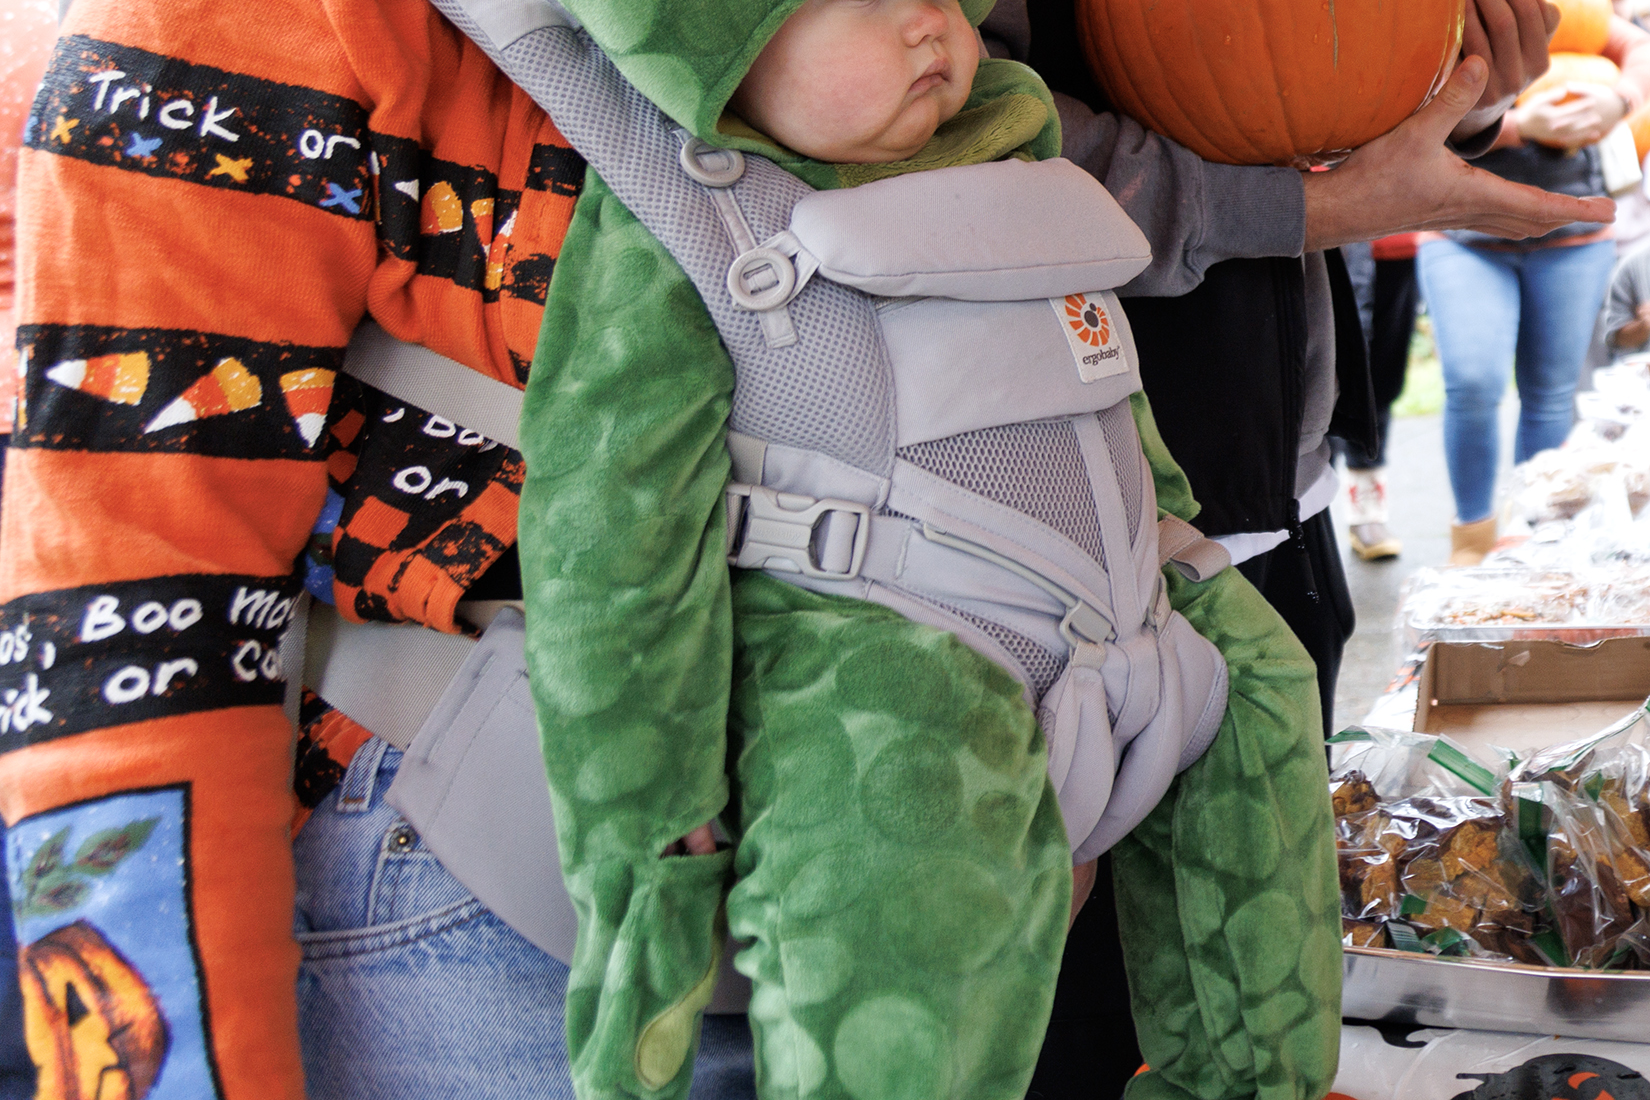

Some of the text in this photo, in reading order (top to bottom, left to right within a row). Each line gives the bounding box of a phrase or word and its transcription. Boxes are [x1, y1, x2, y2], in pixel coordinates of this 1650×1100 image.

[89, 70, 361, 160] Trick or
[1082, 346, 1120, 366] ergobaby
[393, 465, 469, 501] or
[79, 594, 203, 642] Boo
[103, 657, 198, 704] or
